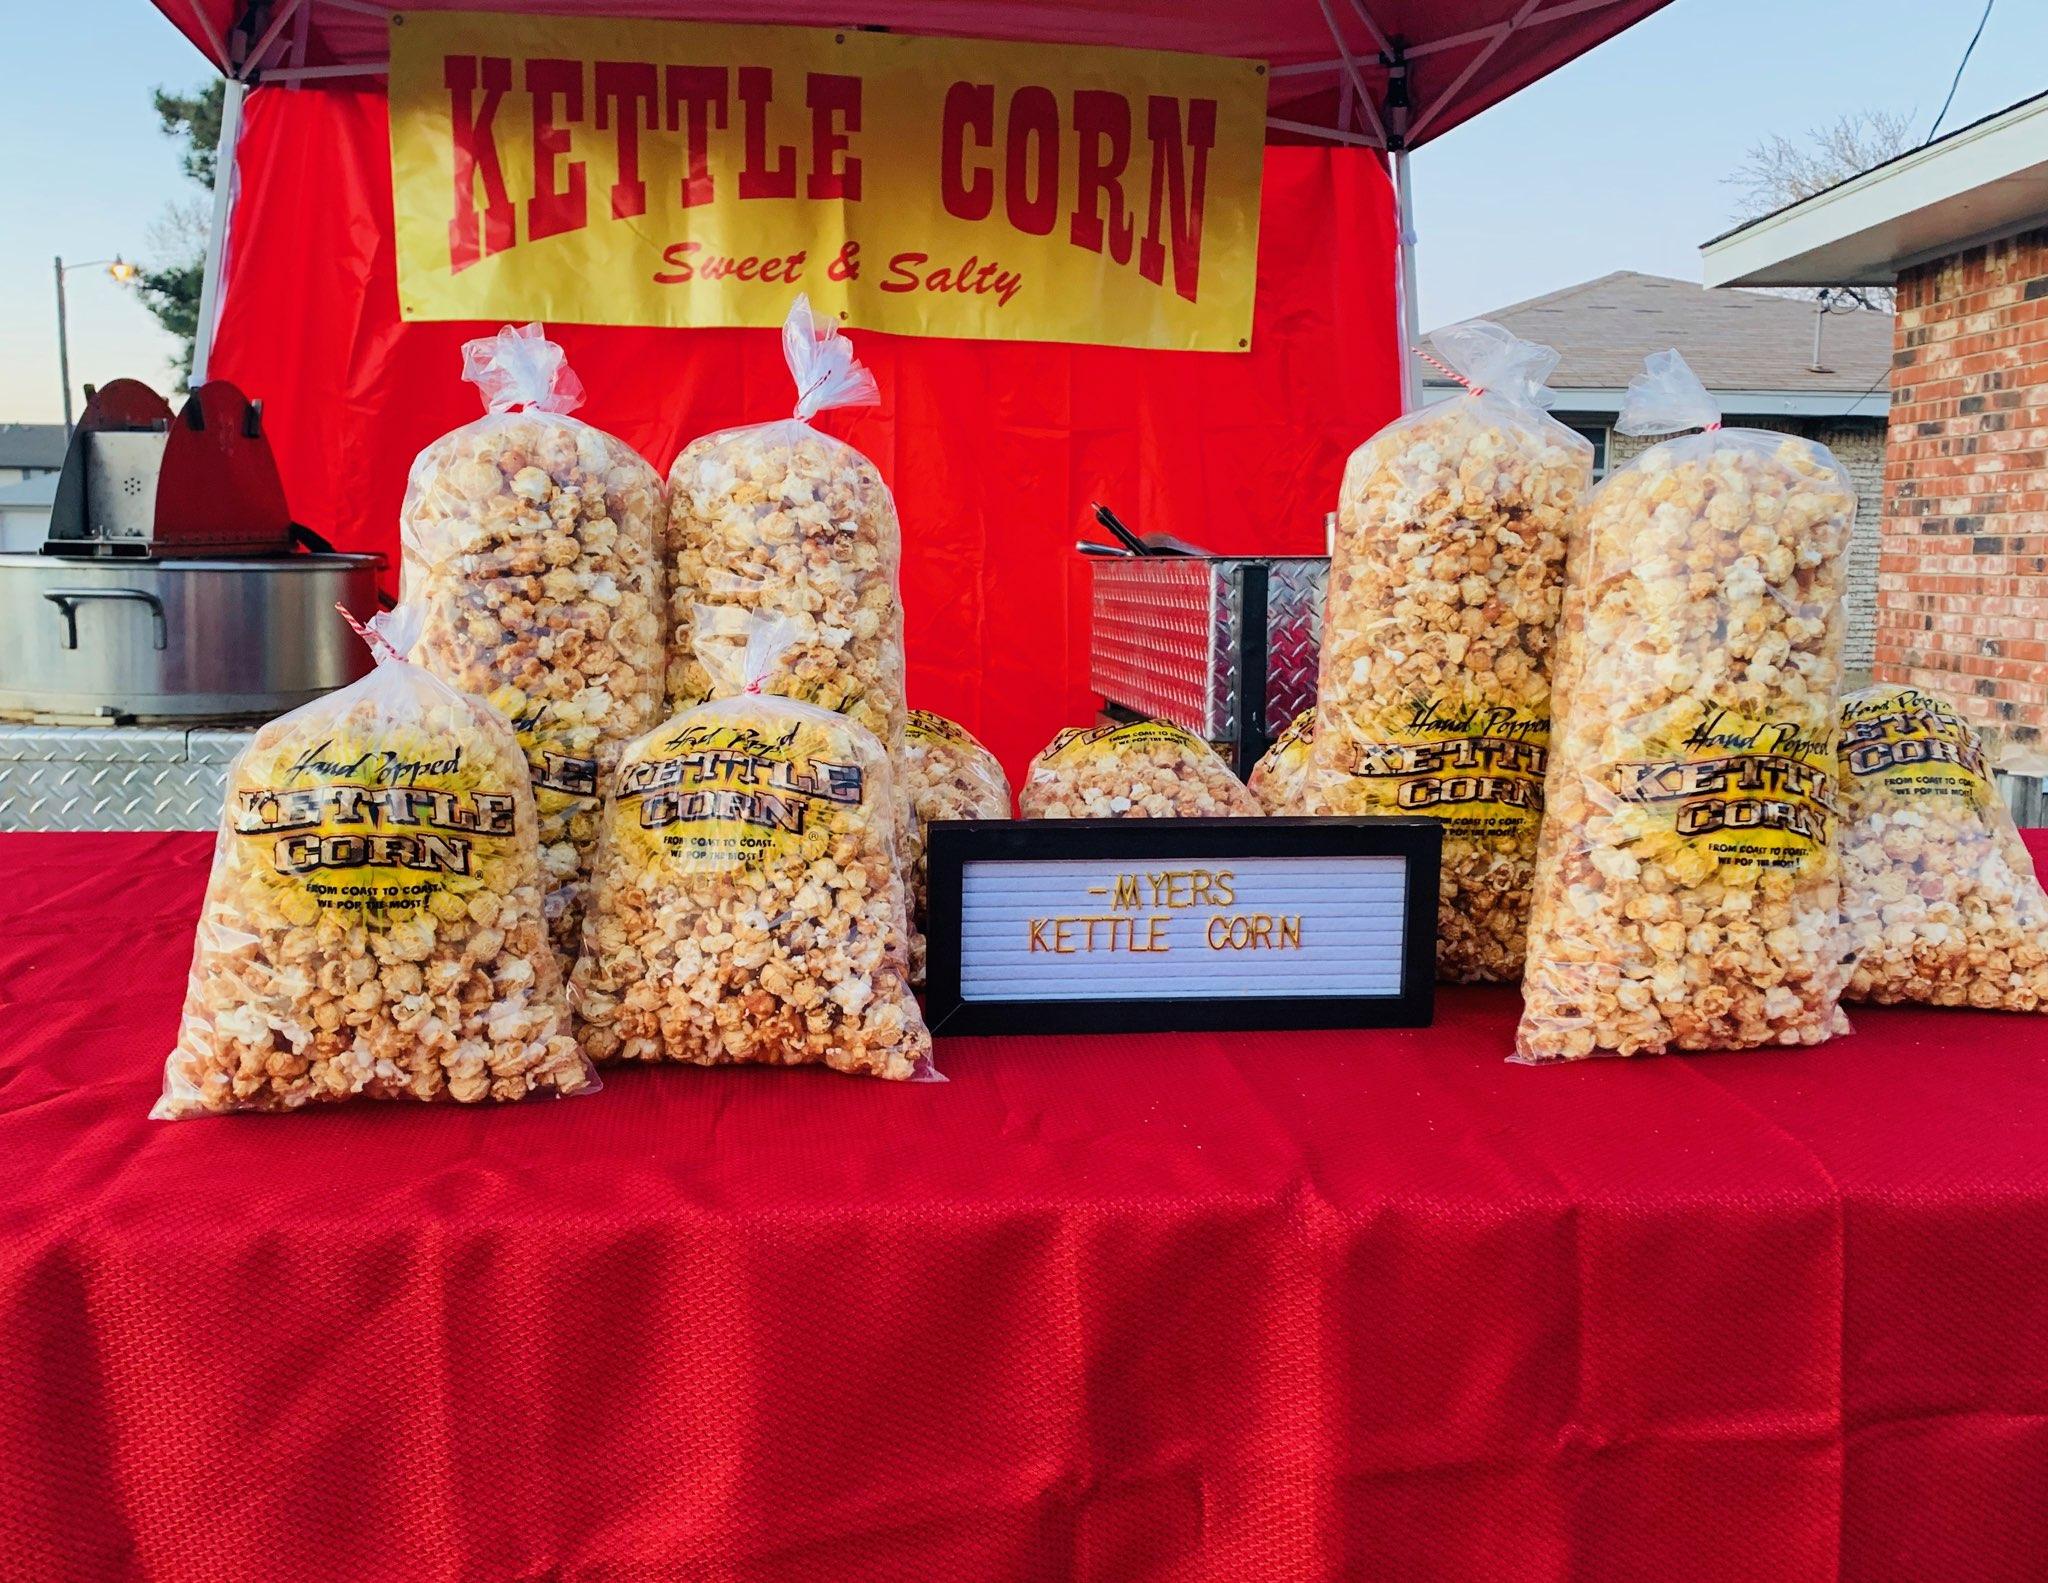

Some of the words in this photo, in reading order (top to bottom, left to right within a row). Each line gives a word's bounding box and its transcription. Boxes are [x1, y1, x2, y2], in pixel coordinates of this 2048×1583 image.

[443, 54, 862, 277] KETTLE
[941, 79, 1219, 305] CORN
[653, 242, 806, 285] Sweet
[827, 242, 860, 281] &
[880, 252, 1022, 307] Salty
[1407, 699, 1479, 736] Hand
[1682, 709, 1771, 752] Hand
[1770, 722, 1833, 762] Popped
[286, 738, 371, 783] Hand
[376, 746, 461, 787] Popped
[1350, 736, 1547, 777] KETTL
[1849, 738, 1987, 781] CORN
[615, 750, 863, 804] KETTLE
[1398, 776, 1545, 812] CORN
[1614, 753, 1839, 816] KETTL
[1884, 777, 1912, 785] FROM
[1945, 777, 1956, 785] TO
[1914, 787, 1932, 795] POP
[234, 784, 515, 836] KETTLE
[640, 791, 808, 835] CORN
[1484, 817, 1496, 826] TO
[1676, 798, 1827, 846] CORN
[274, 833, 472, 875] CORN
[687, 851, 706, 859] POP
[723, 838, 737, 847] TO
[1708, 843, 1737, 852] FROM
[1770, 847, 1780, 855] TO
[1718, 856, 1731, 864] WE
[1734, 857, 1753, 866] POP
[306, 883, 337, 894] FROM
[341, 886, 378, 896] COAST
[383, 886, 398, 896] TO
[317, 899, 332, 908] WE
[337, 900, 361, 910] POP
[1029, 916, 1171, 953] KETTLE
[1206, 913, 1302, 951] CORN
